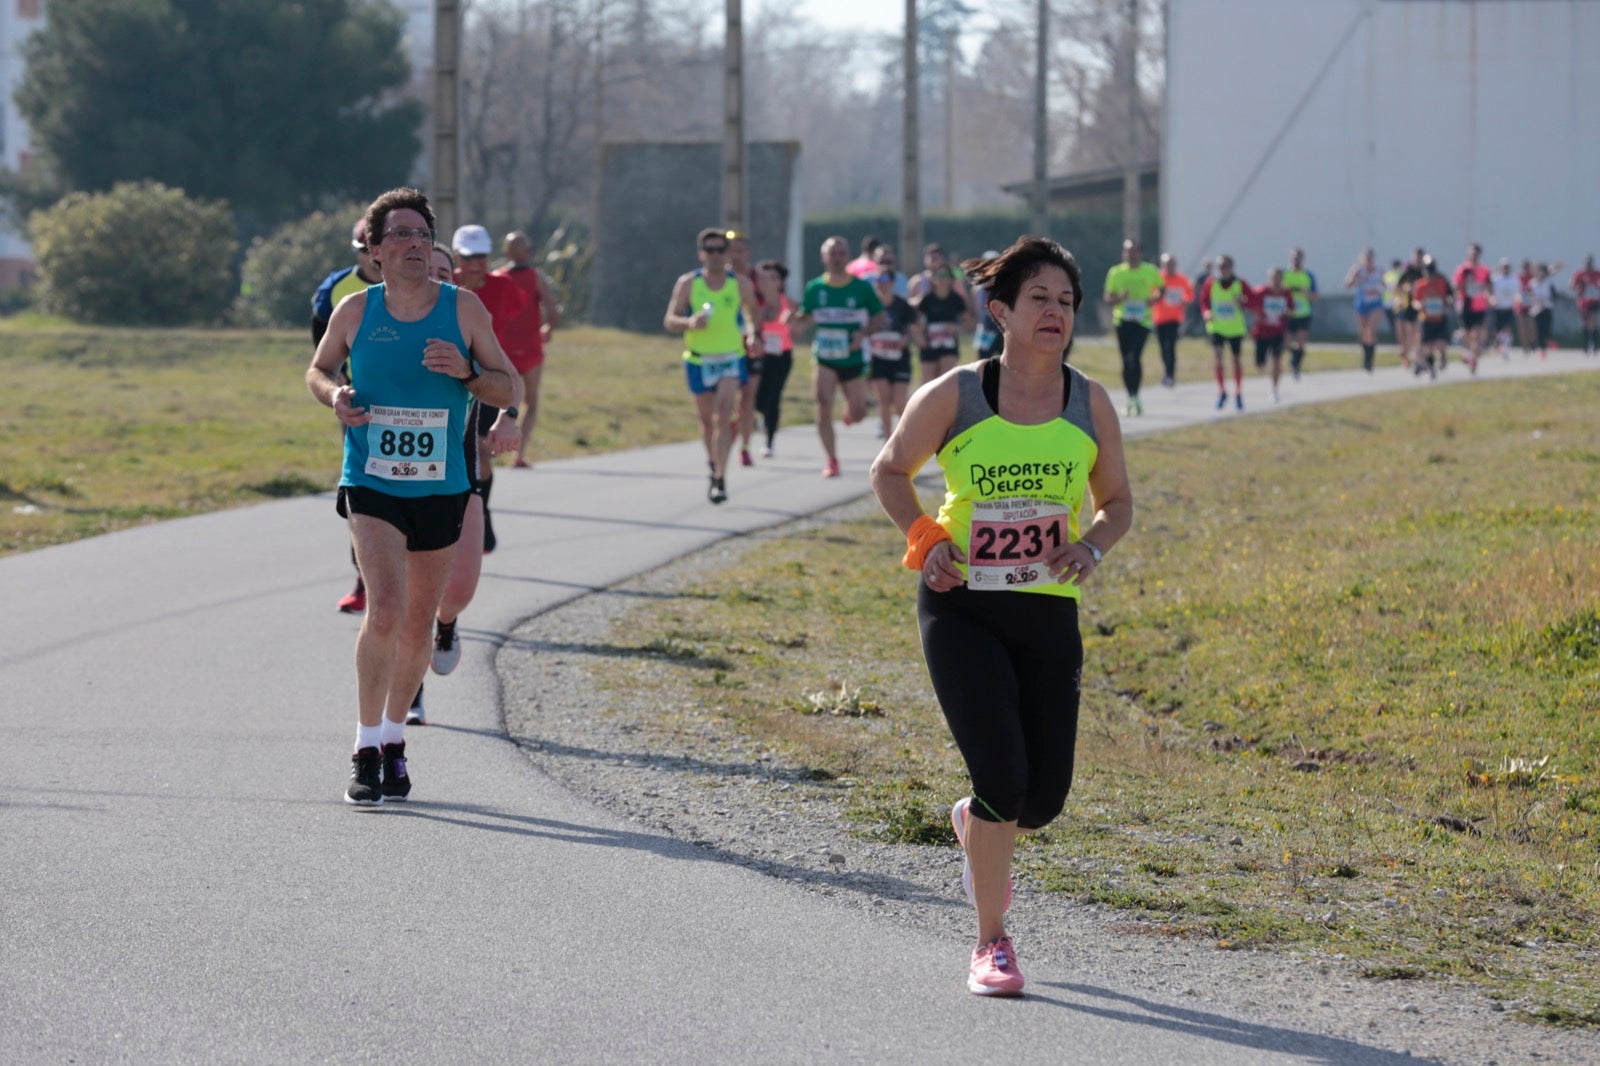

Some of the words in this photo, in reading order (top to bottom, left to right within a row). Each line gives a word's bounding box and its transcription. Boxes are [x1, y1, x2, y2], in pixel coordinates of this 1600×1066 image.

[401, 410, 420, 418] PREMIO
[380, 430, 434, 457] 889
[970, 463, 1060, 485] DEPORTES
[978, 477, 1044, 496] DELFOS
[994, 502, 1009, 510] GRAN
[975, 520, 1061, 560] 2231
